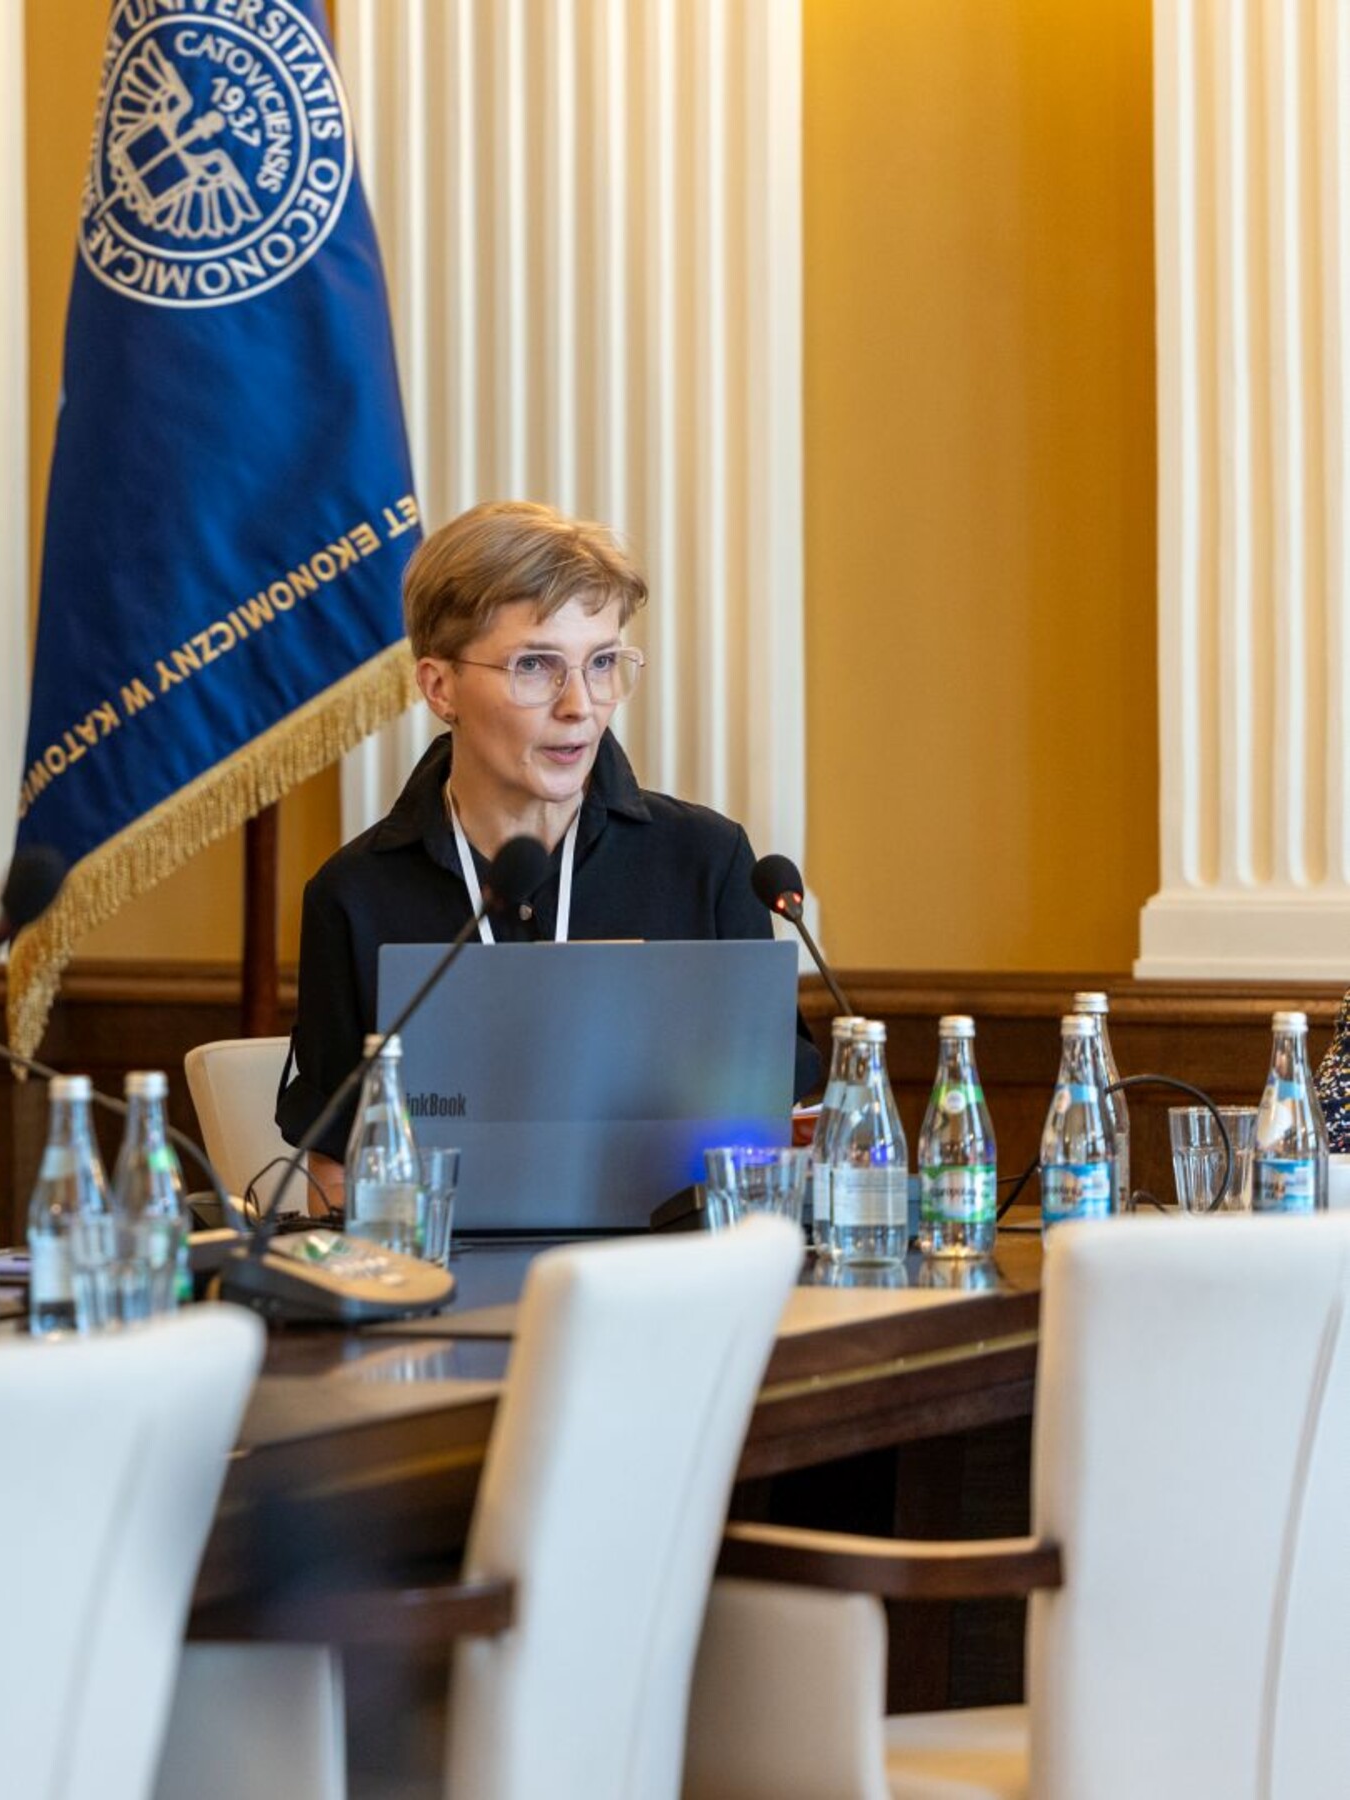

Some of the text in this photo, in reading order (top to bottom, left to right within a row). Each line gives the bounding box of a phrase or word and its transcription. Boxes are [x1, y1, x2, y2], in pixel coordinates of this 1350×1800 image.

[174, 30, 292, 194] CATOVICIENSIS
[210, 77, 262, 147] 1937
[154, 521, 382, 693] EKONOMICZNY
[119, 677, 156, 716] W
